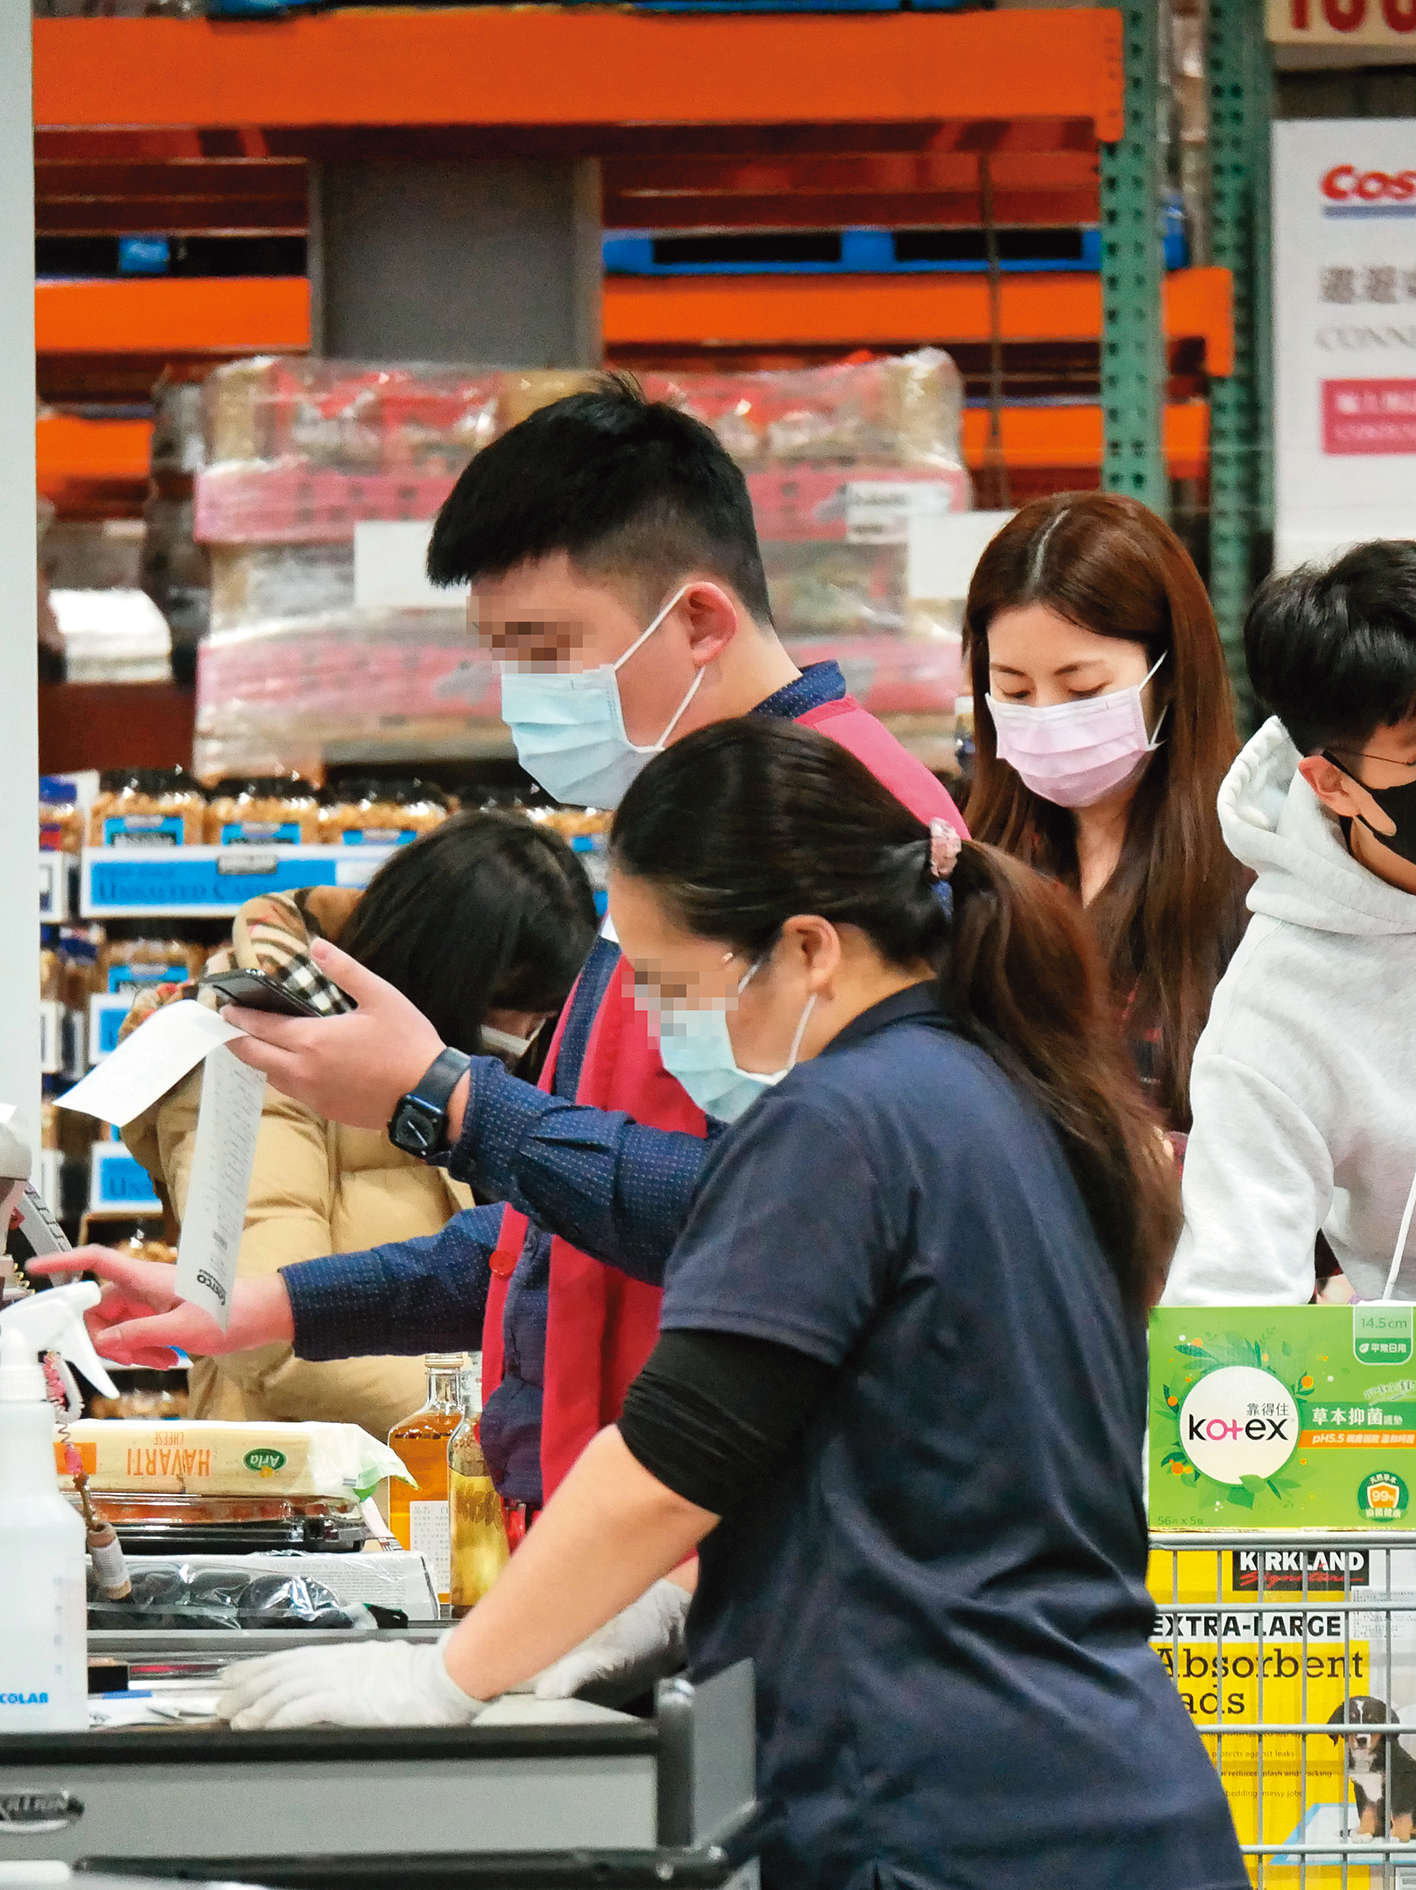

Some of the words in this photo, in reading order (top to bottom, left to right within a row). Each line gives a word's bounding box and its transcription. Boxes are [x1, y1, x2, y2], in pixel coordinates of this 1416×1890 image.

[1247, 1403, 1289, 1416] 靠得住
[154, 1431, 184, 1446] CHEESE
[1312, 1434, 1345, 1445] pH5.5
[127, 1448, 211, 1477] HAVARTI
[250, 1454, 280, 1468] Arla
[1180, 1684, 1245, 1715] ads
